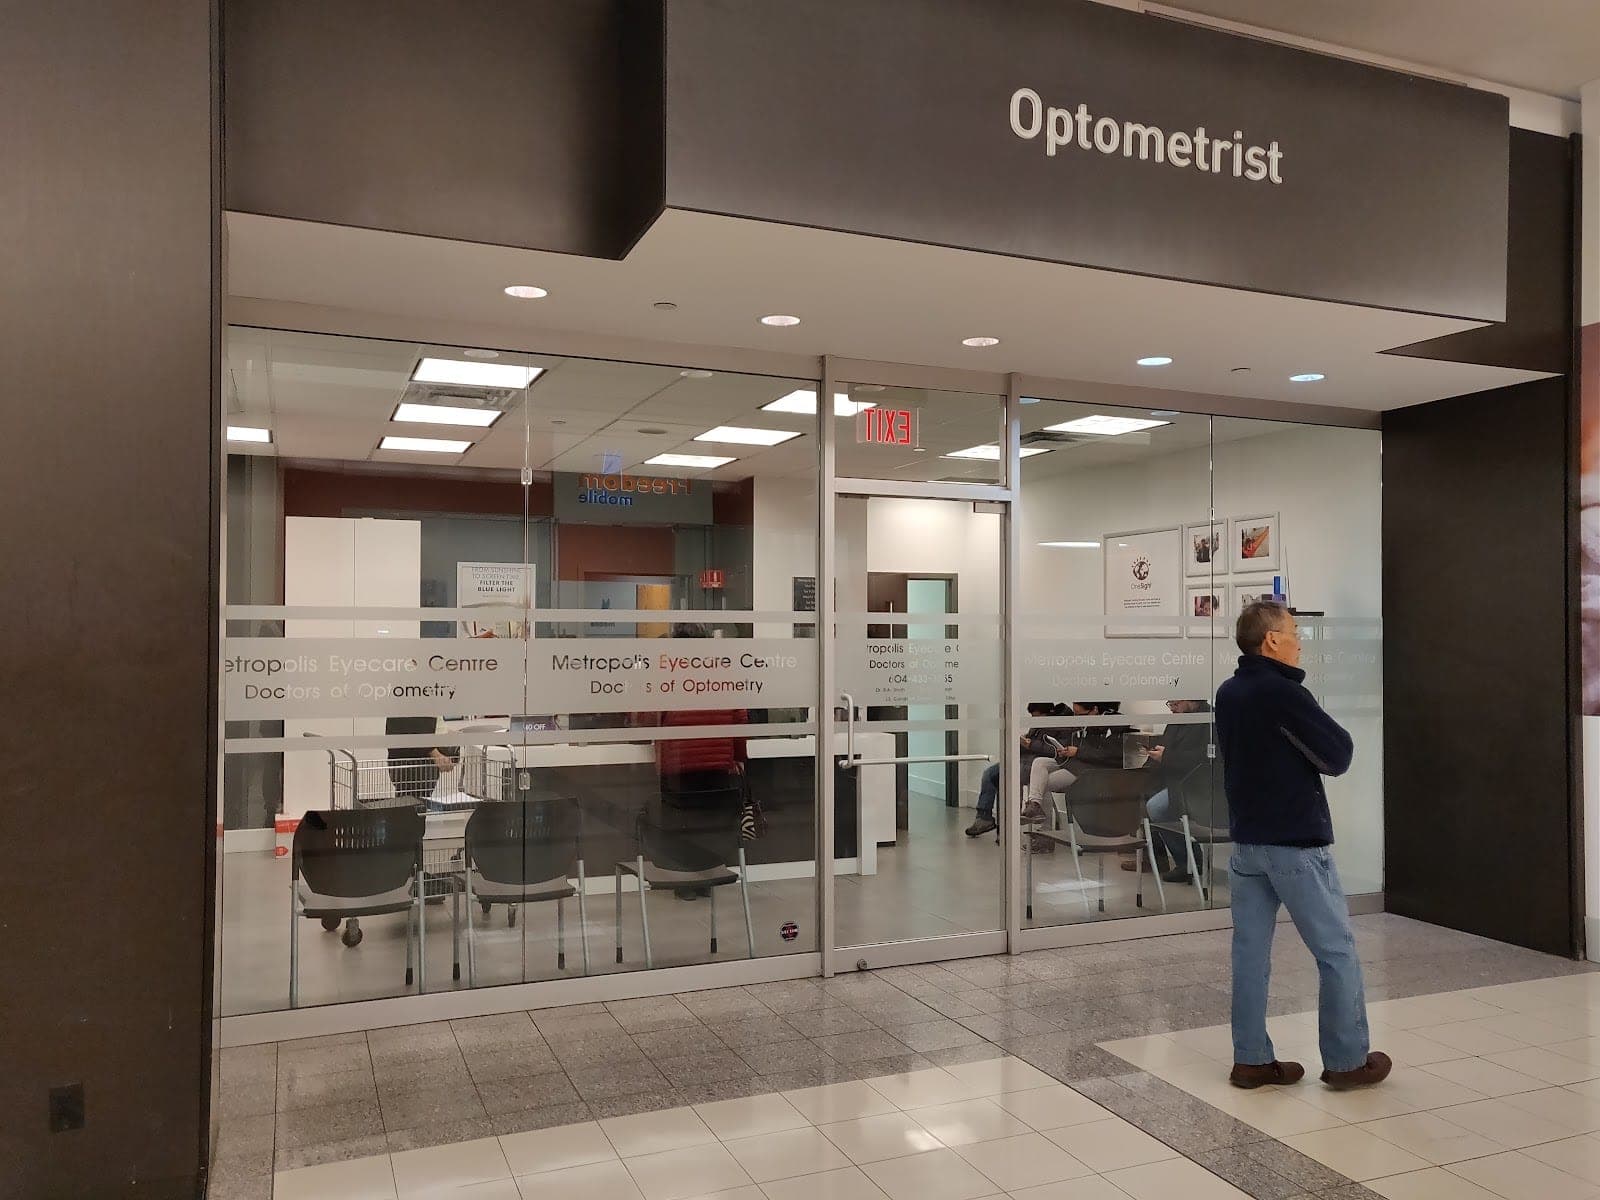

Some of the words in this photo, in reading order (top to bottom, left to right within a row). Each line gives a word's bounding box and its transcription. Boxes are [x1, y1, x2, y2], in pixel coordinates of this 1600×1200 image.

[1010, 87, 1283, 184] Optometrist
[329, 655, 418, 675] Eyecare
[429, 655, 499, 672] Centre
[552, 653, 650, 673] Metropolis
[659, 653, 732, 672] Eyecare
[740, 653, 798, 669] Centre
[869, 659, 905, 669] Doctors
[1162, 651, 1205, 666] Centre
[245, 682, 321, 700] Doctors
[358, 682, 456, 700] Optometry
[591, 680, 652, 694] Docs
[660, 679, 676, 693] of
[682, 678, 764, 695] Optometry
